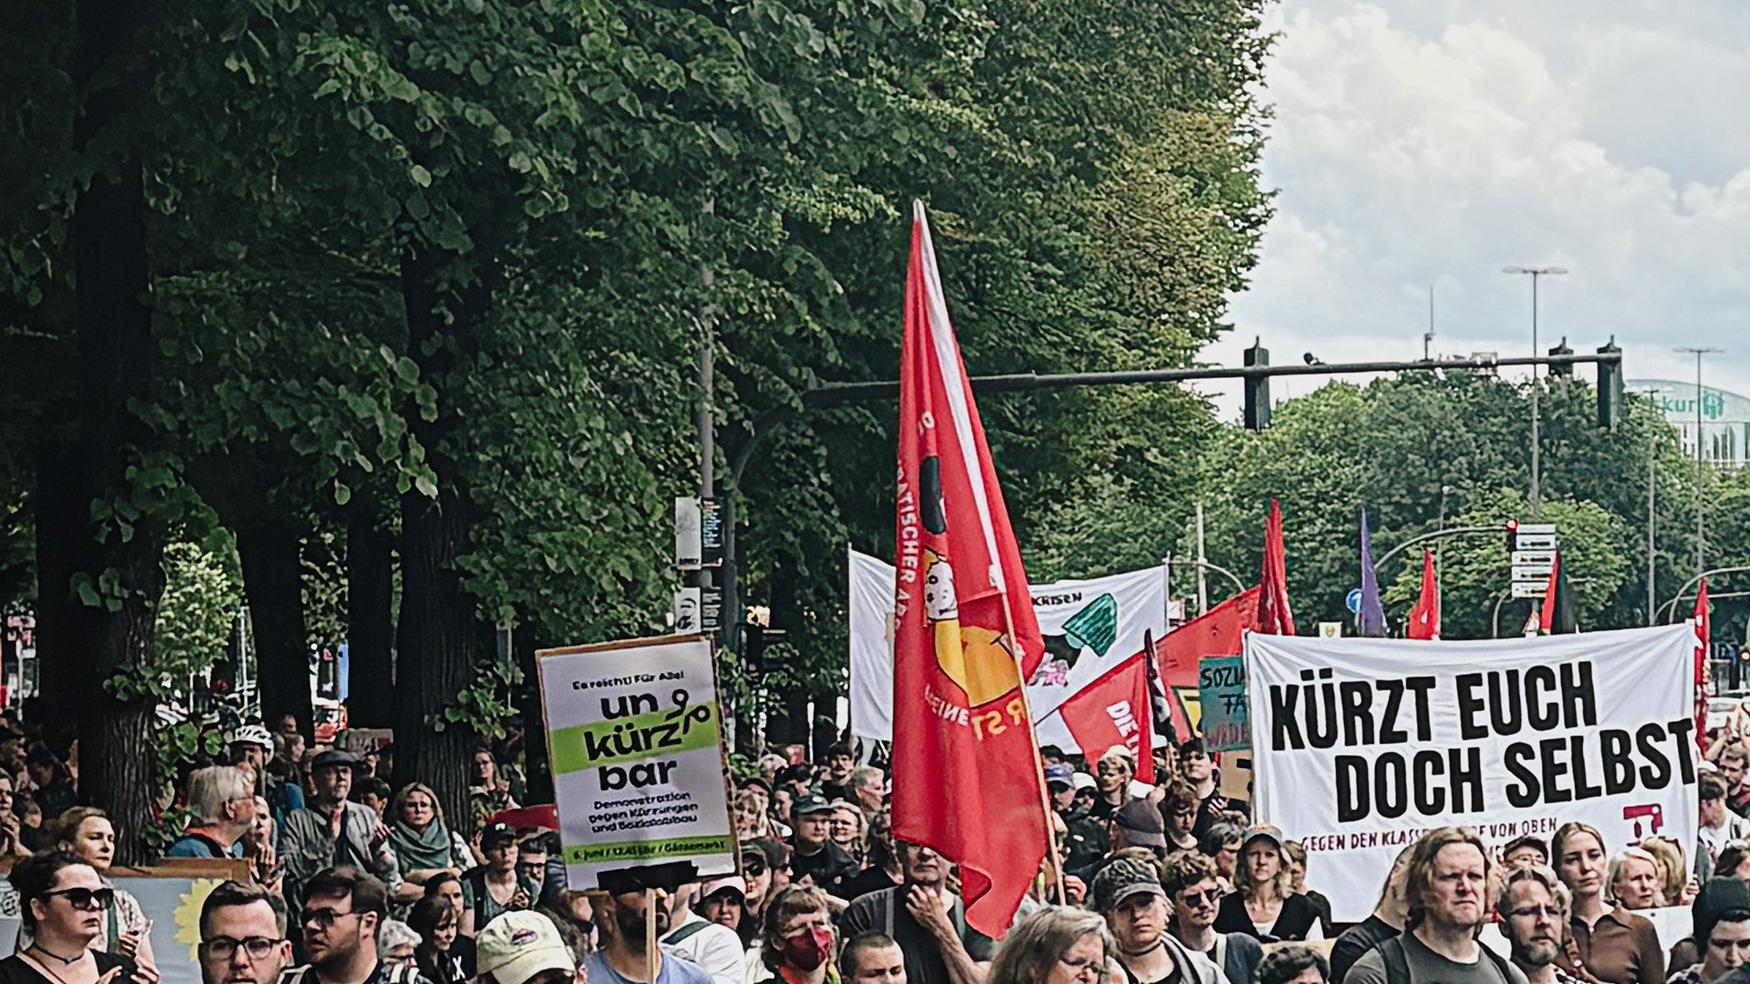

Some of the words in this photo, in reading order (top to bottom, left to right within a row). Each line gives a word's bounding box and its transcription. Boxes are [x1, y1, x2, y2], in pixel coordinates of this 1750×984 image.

[601, 693, 658, 720] un
[1269, 667, 1436, 751] KÜRZT
[1455, 661, 1597, 741] EUCH
[584, 722, 682, 761] kürz
[598, 760, 677, 791] bar
[1335, 747, 1485, 823] DOCH
[1503, 718, 1697, 808] SELBST
[594, 792, 691, 810] Demonstration
[629, 803, 698, 818] Kürzungen
[592, 822, 617, 833] und
[1350, 832, 1378, 849] DEN
[1490, 823, 1517, 838] VON
[1521, 817, 1557, 836] OBEN
